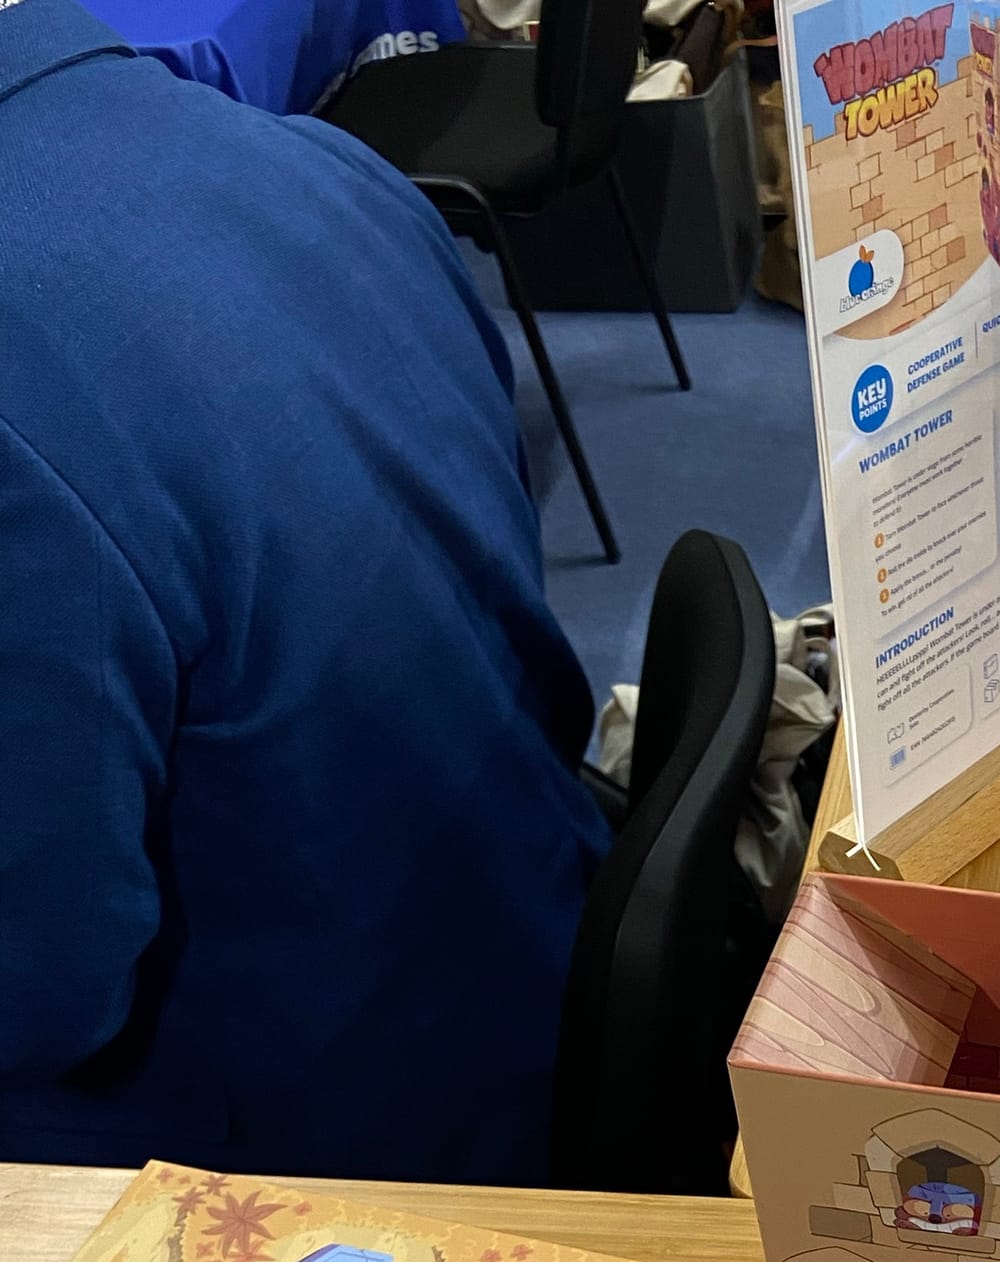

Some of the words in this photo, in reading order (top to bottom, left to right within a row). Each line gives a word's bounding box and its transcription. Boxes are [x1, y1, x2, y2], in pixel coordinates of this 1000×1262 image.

[814, 3, 954, 105] WOMBAT
[844, 67, 939, 141] TOWER
[907, 336, 963, 375] COOPERATIVE
[907, 367, 941, 393] DEFENSE
[942, 352, 965, 373] GAME
[857, 378, 886, 409] KEY
[859, 400, 887, 421] POINTS
[859, 433, 911, 474] WOMBAT
[913, 409, 953, 442] TOWER
[875, 606, 954, 669] INTRODUCTION
